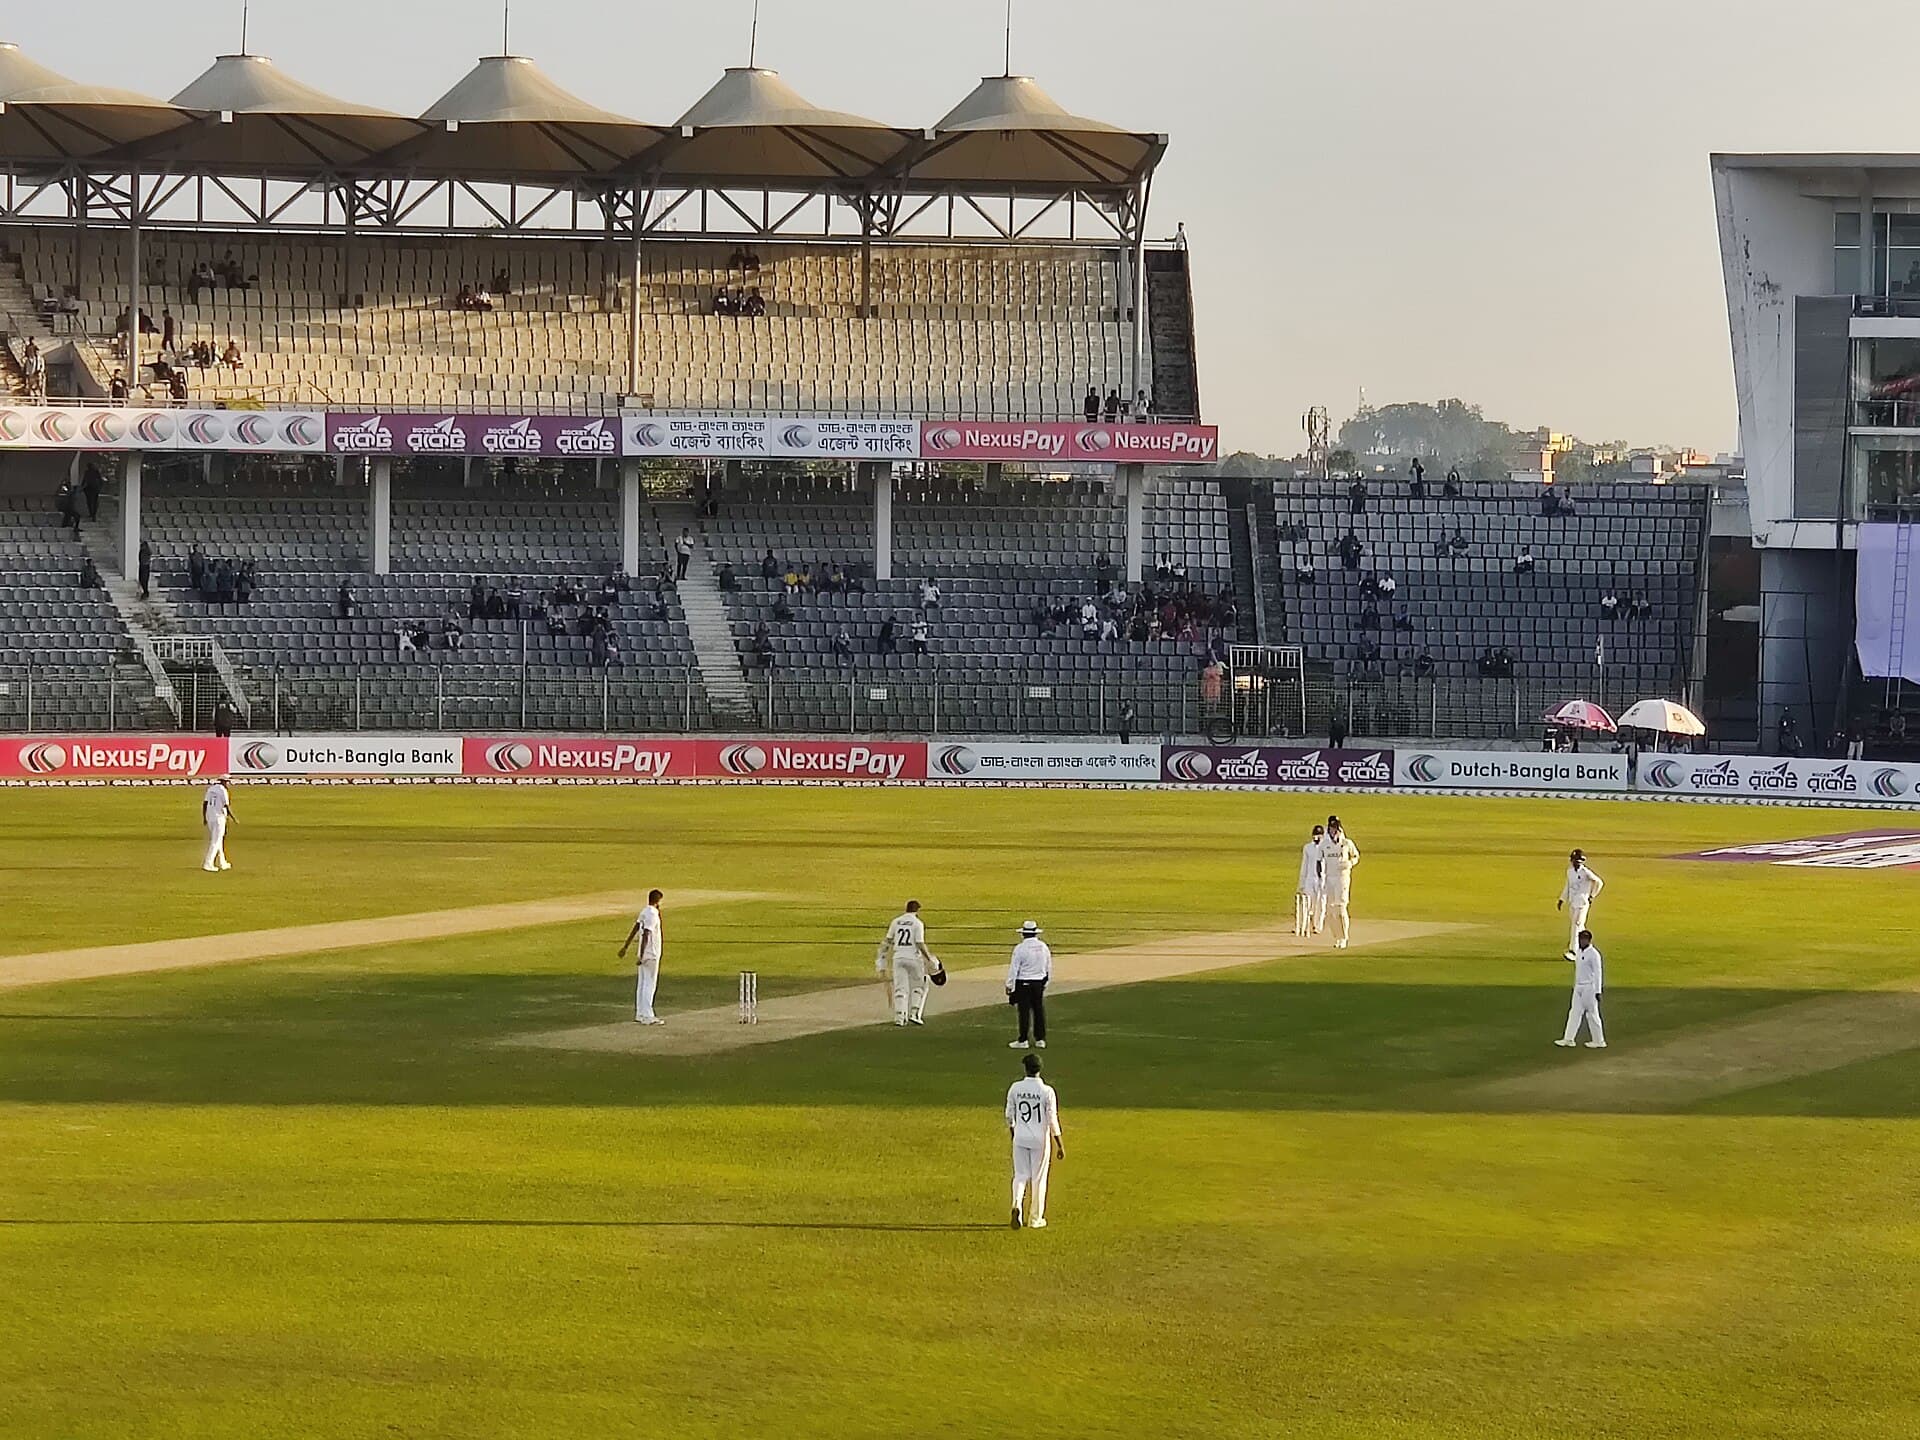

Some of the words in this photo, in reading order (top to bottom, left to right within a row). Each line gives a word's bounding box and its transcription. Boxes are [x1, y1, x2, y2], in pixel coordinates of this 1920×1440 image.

[670, 432, 711, 449] এজেন্ট
[715, 431, 765, 451] ব্যাংকিং
[818, 433, 859, 451] এজেন্ট
[863, 433, 913, 453] ব্যাংকিং
[965, 429, 1065, 456] NexusPay
[1114, 431, 1214, 459] NexusPay
[72, 743, 206, 776] NexusPay
[286, 748, 405, 767] Dutch-Bangla
[411, 748, 454, 764] Bank
[538, 744, 672, 777] NexusPay
[772, 746, 905, 779] NexusPay
[1085, 754, 1117, 768] এজেন্ট
[1120, 753, 1156, 769] ব্যাংকিং
[1451, 762, 1570, 782] Dutch-Bangla
[1576, 764, 1620, 780] Bank
[897, 928, 913, 946] 22
[1018, 1100, 1042, 1124] 91
